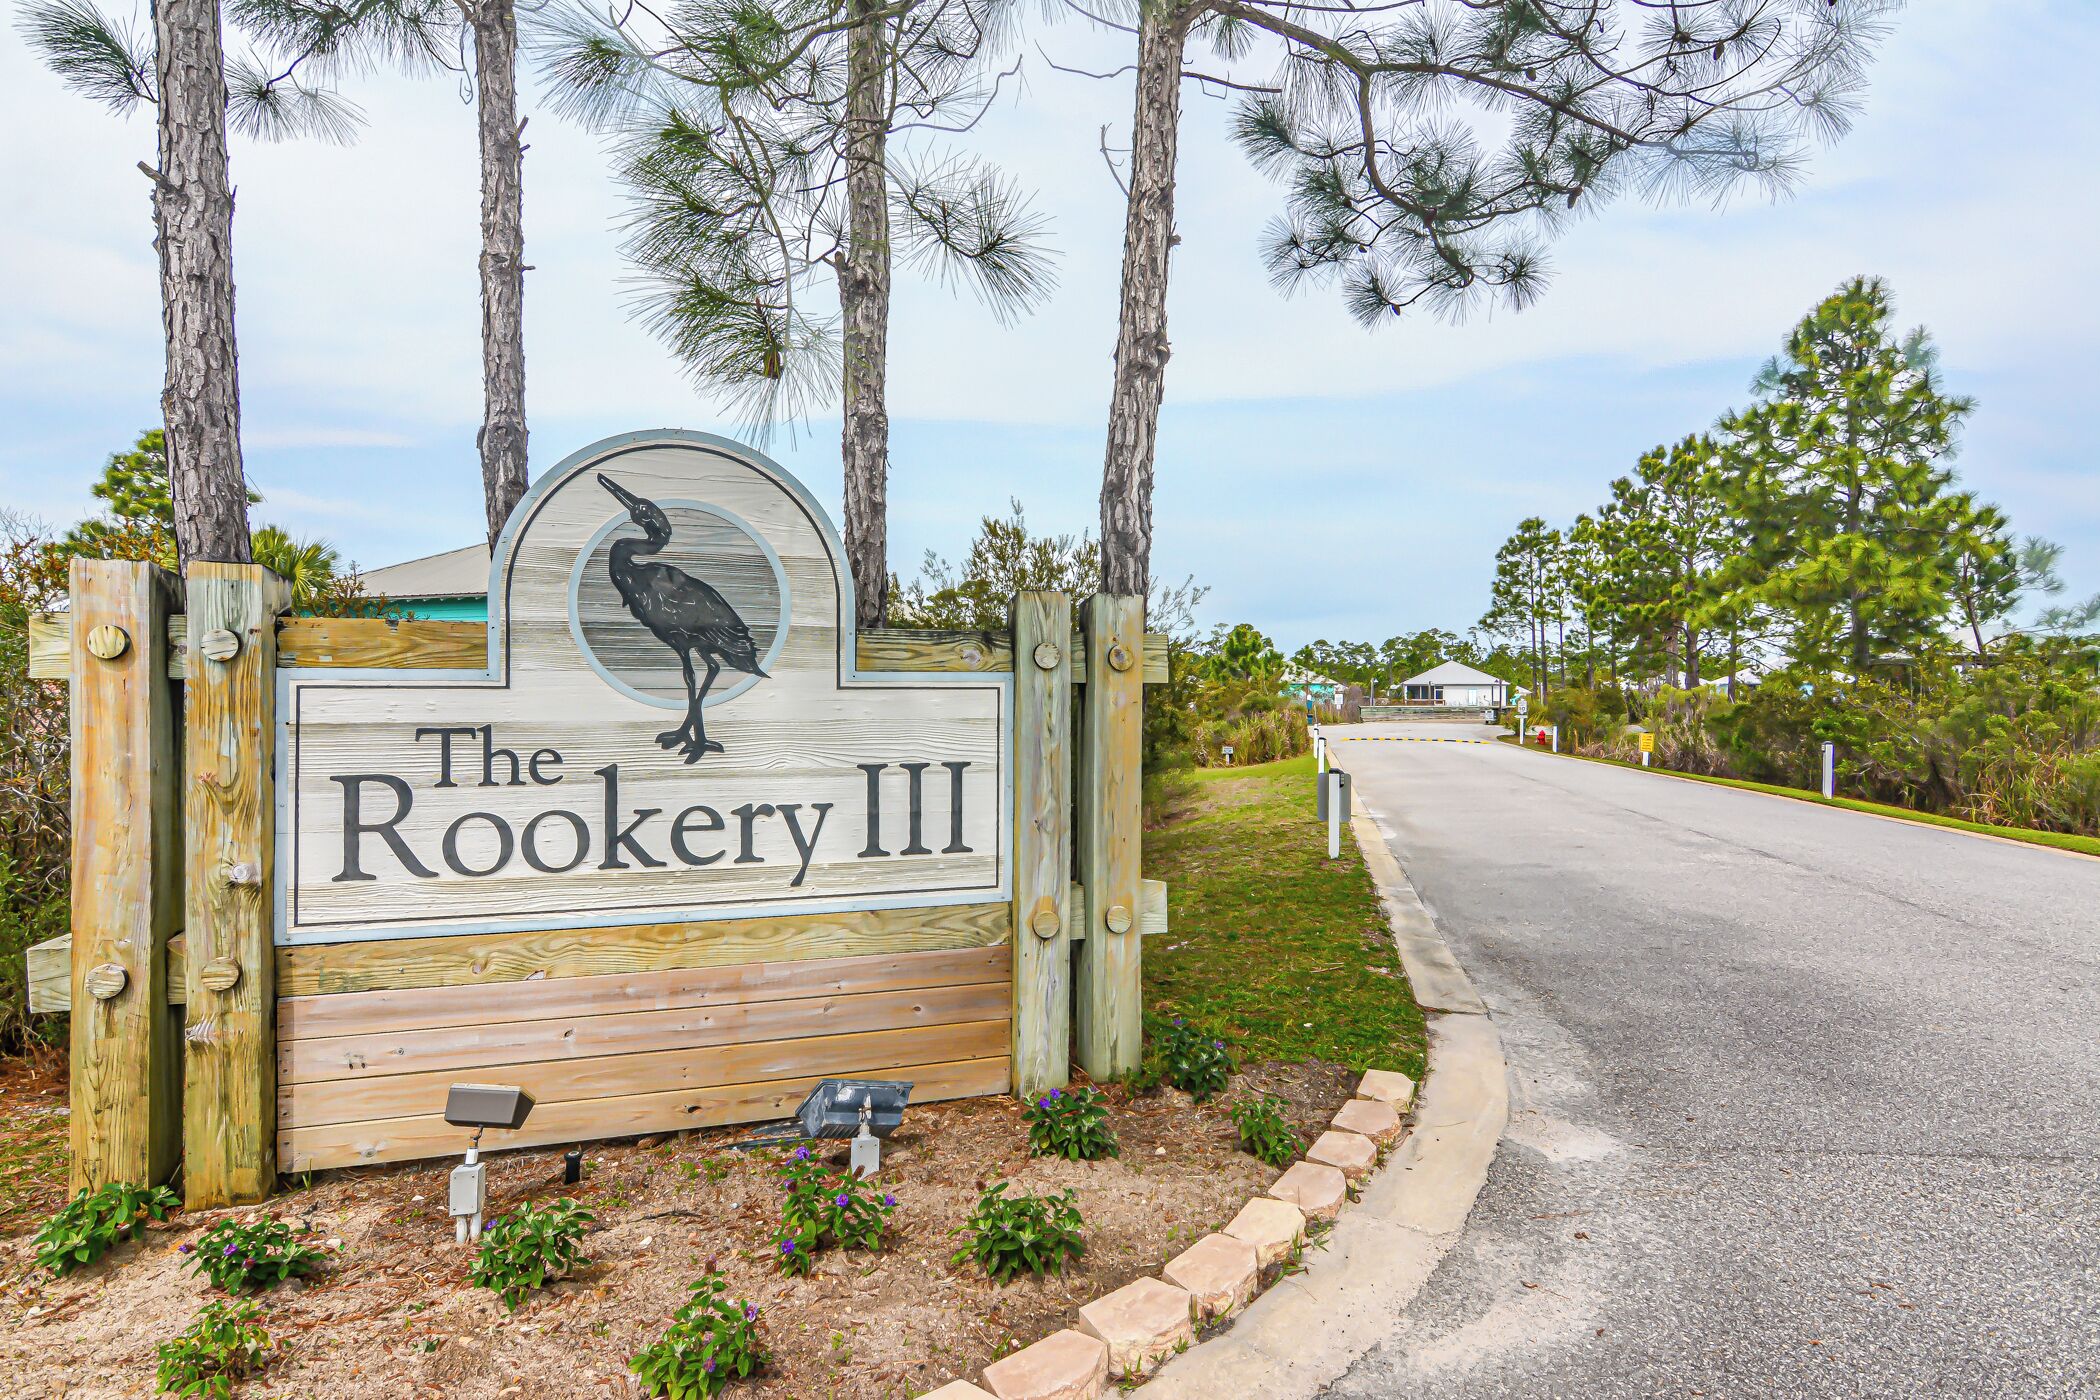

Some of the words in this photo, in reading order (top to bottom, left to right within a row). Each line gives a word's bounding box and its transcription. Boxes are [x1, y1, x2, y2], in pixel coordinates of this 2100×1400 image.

[415, 724, 565, 788] The
[329, 763, 834, 888] Rookery
[857, 761, 974, 857] III
